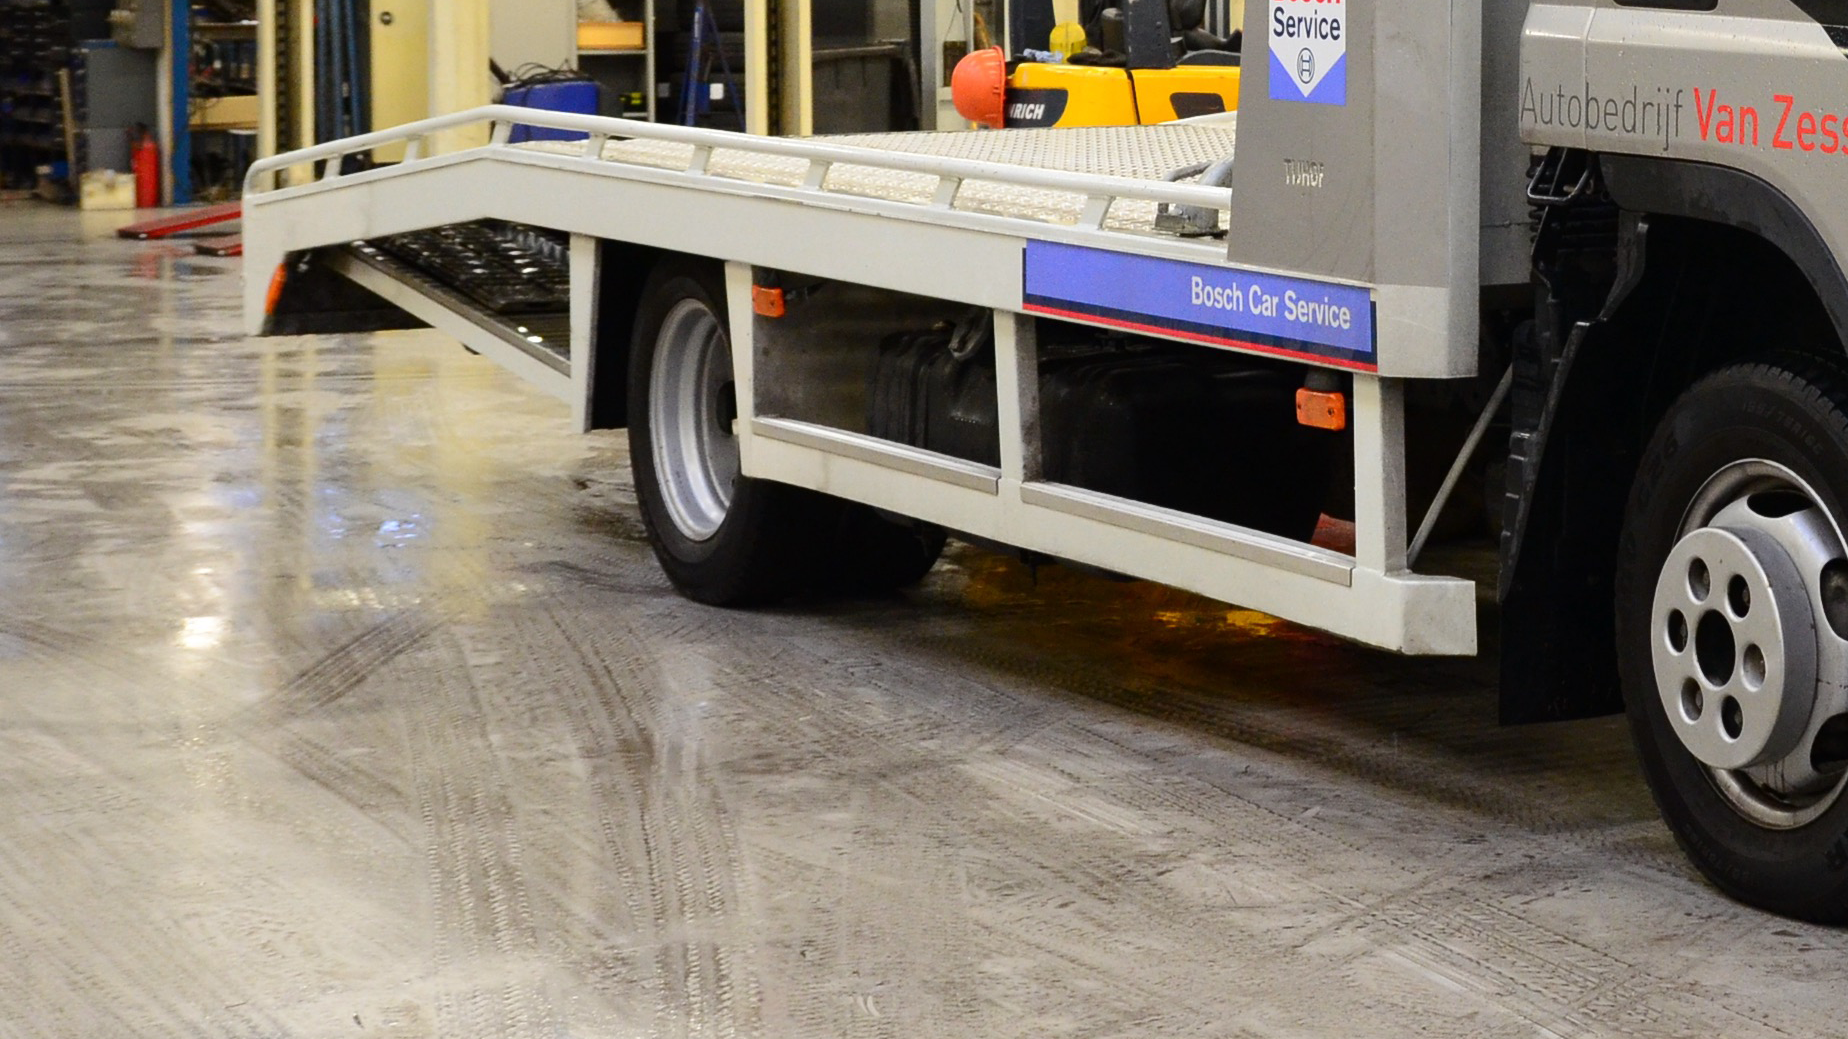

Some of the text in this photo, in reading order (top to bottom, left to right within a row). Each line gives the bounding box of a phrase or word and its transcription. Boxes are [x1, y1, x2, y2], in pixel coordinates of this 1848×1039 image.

[1273, 6, 1340, 40] Service
[1520, 77, 1683, 152] Autobedrijf
[1693, 87, 1759, 147] Van
[1191, 276, 1351, 330] Bosch Car Service
